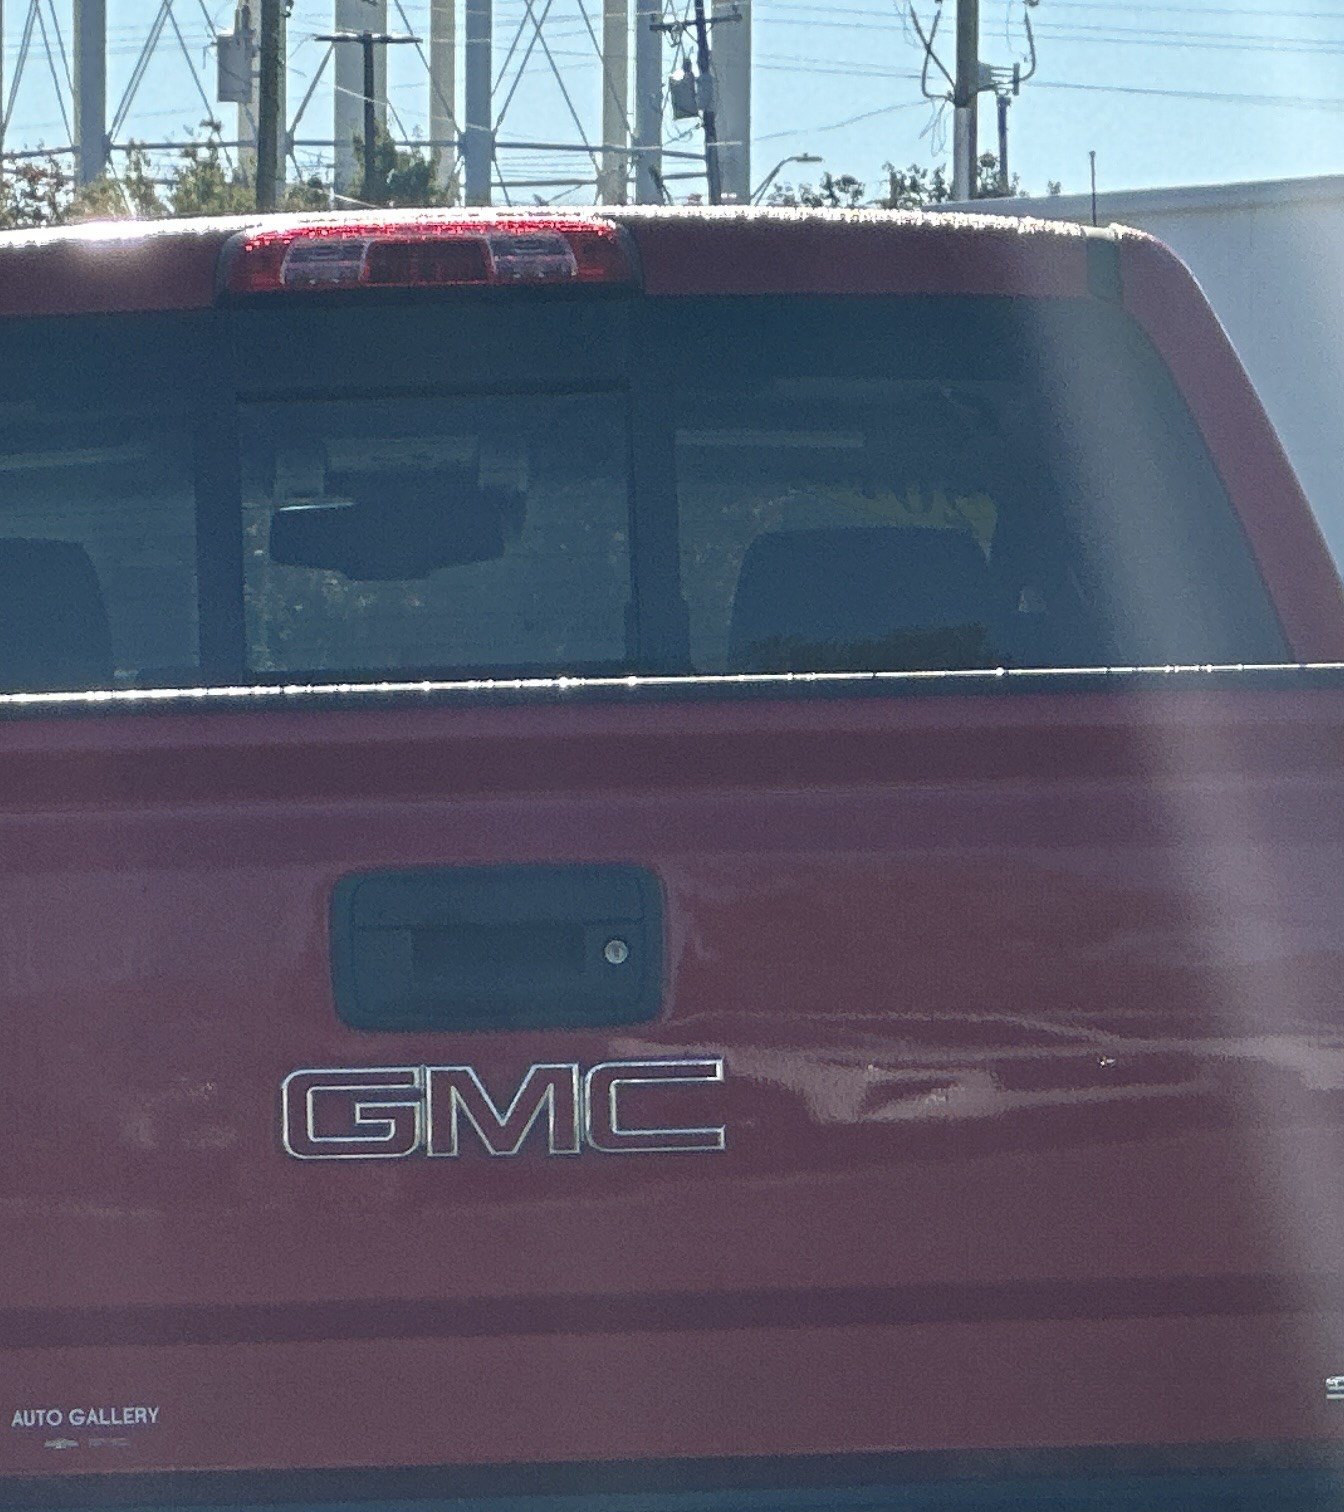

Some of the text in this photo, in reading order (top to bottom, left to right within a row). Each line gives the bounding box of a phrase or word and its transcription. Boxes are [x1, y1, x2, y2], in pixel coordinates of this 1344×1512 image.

[282, 1057, 726, 1160] GMC
[11, 1406, 160, 1427] AUTO GALLERY
